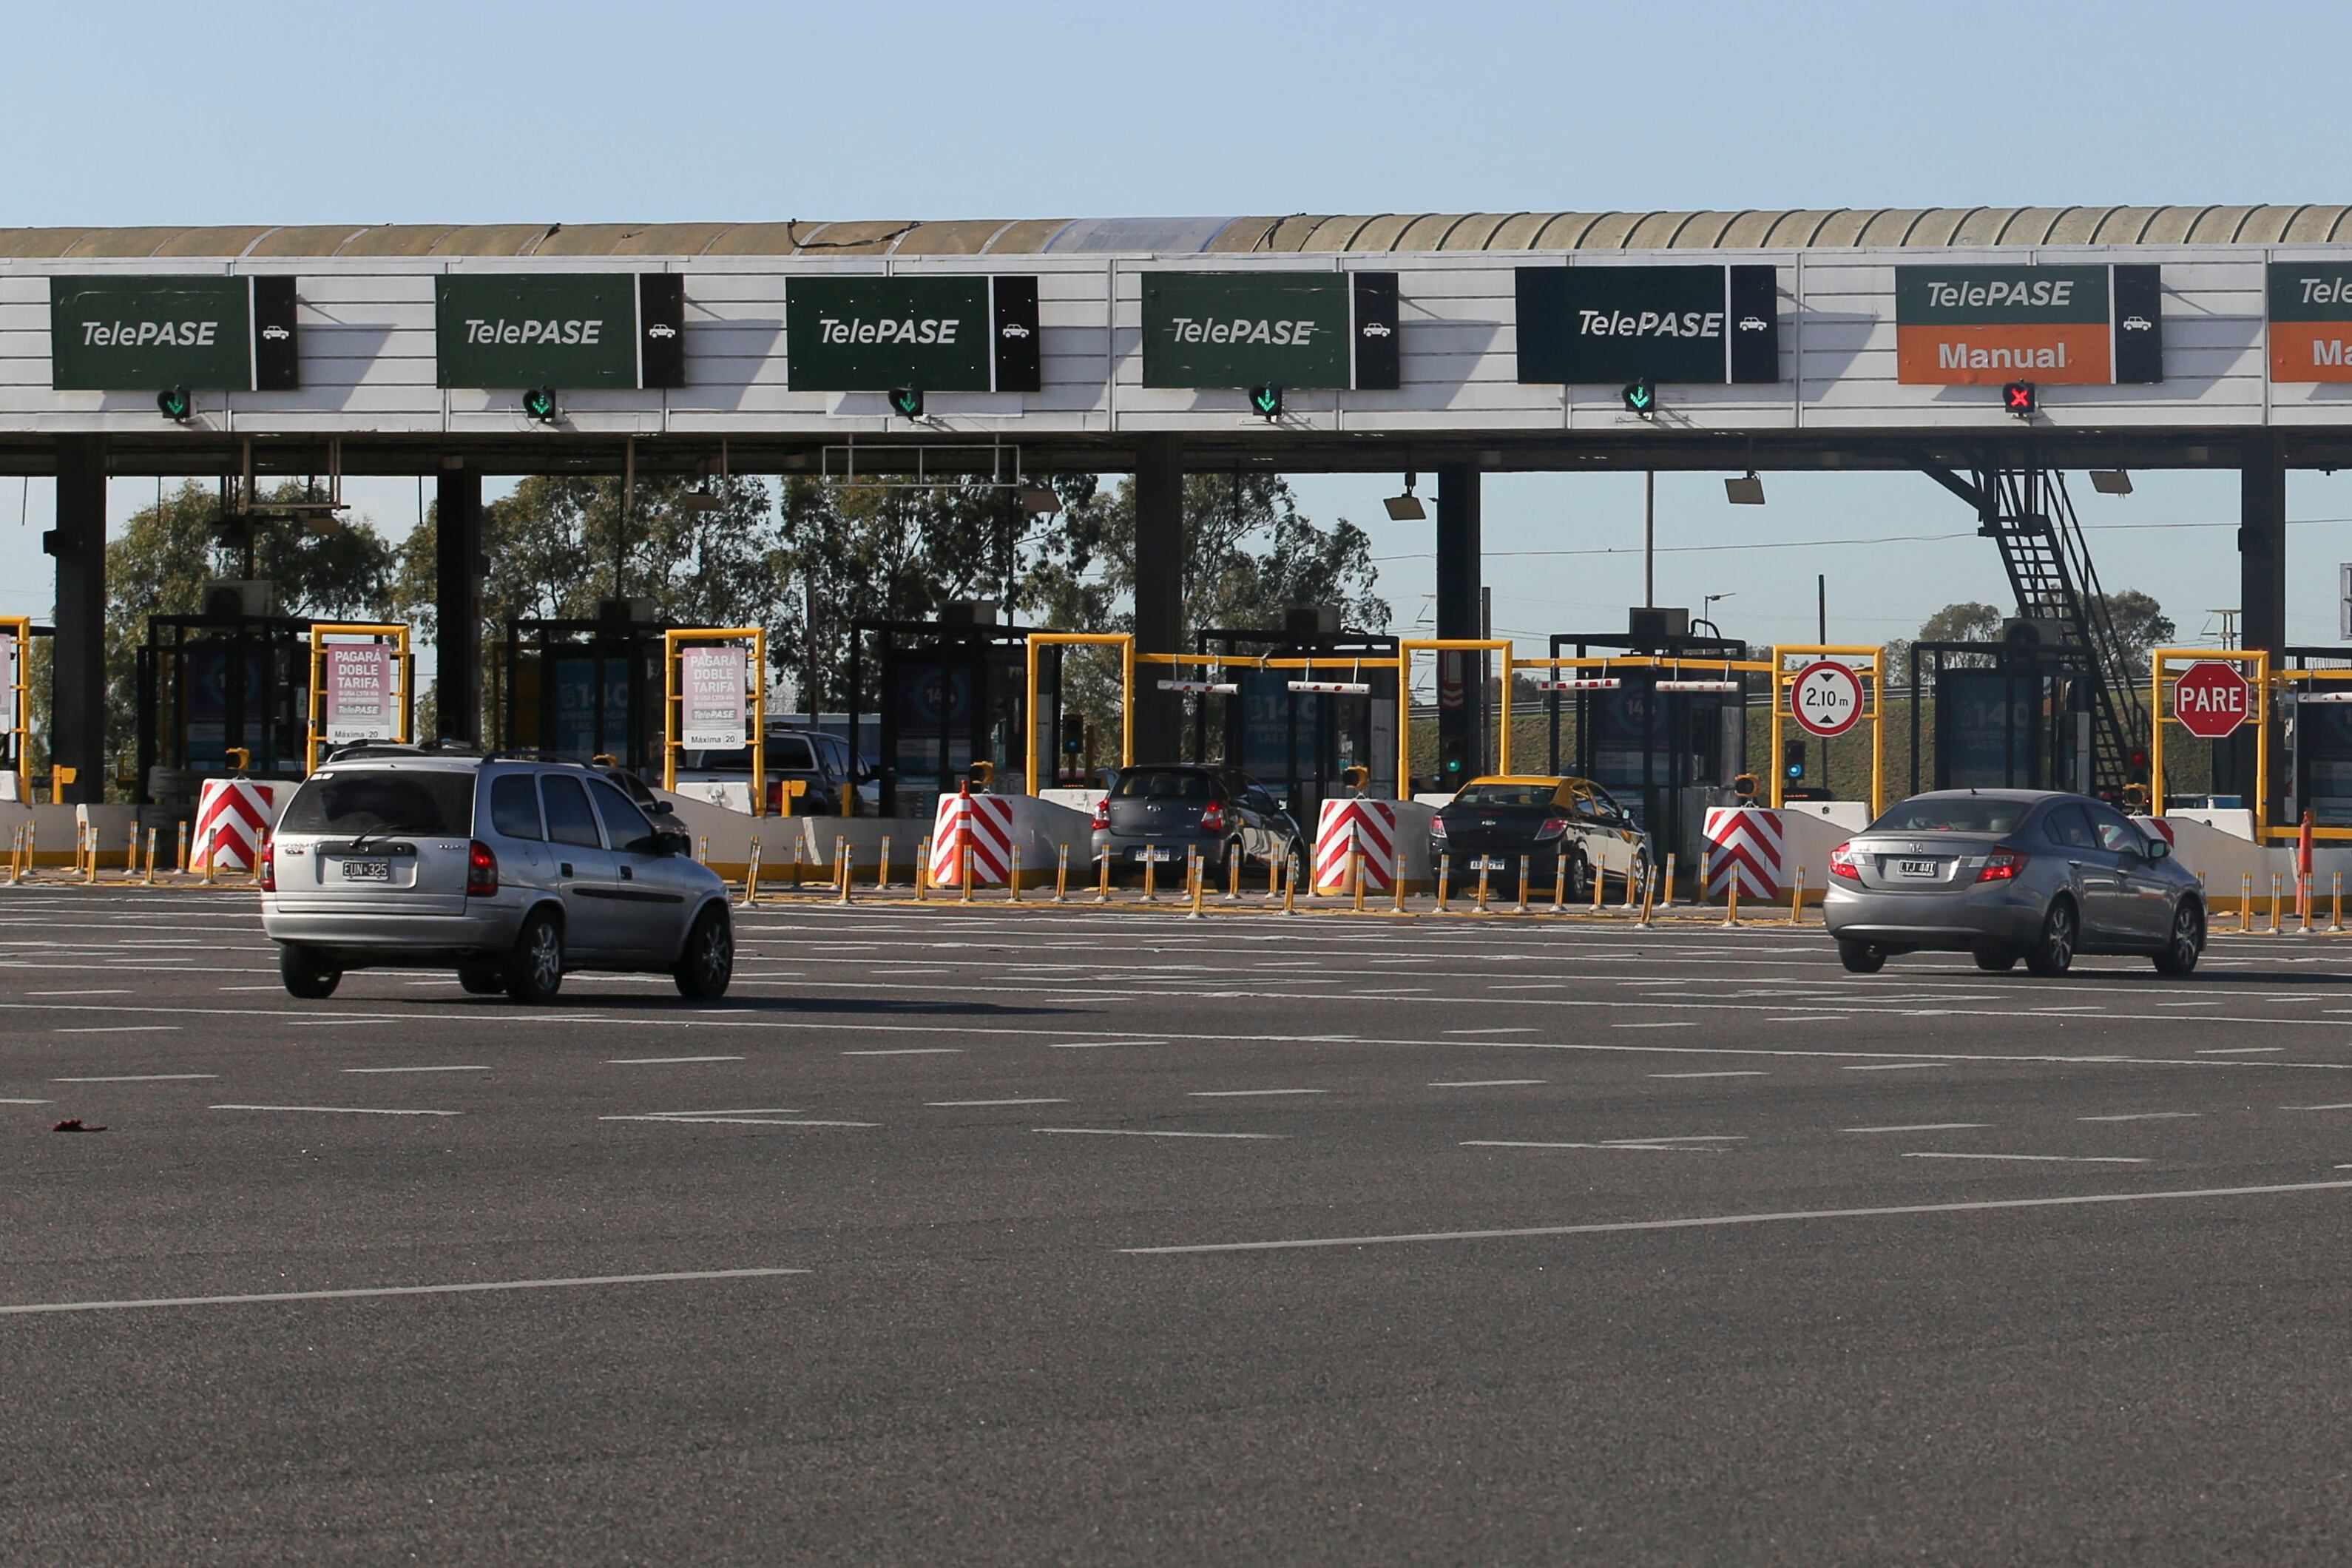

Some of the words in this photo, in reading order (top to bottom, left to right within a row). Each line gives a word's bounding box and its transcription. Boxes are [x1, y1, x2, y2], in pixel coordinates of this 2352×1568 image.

[1927, 280, 2074, 307] TelePASE
[1578, 310, 1724, 337] TelePASE
[81, 320, 218, 346] TelePASE
[465, 319, 603, 345] TelePASE
[820, 318, 960, 344] TelePASE
[1172, 317, 1315, 345] TelePASE
[1939, 342, 2065, 369] Manual
[335, 649, 382, 663] PAGARÁ
[691, 652, 737, 666] PAGARÁ
[339, 664, 379, 675] DOBLE
[695, 669, 734, 680] DOBLE
[337, 677, 380, 689] TARIFA
[692, 681, 735, 692] TARIFA
[1806, 687, 1836, 707] 2,10
[1839, 698, 1848, 706] m
[2180, 686, 2243, 712] PARE
[338, 706, 379, 714] TelePASE
[693, 710, 735, 719] TelePASE
[334, 729, 365, 738] Máxima
[691, 734, 722, 743] Máxima
[344, 862, 363, 876] EUN
[369, 863, 387, 876] 325
